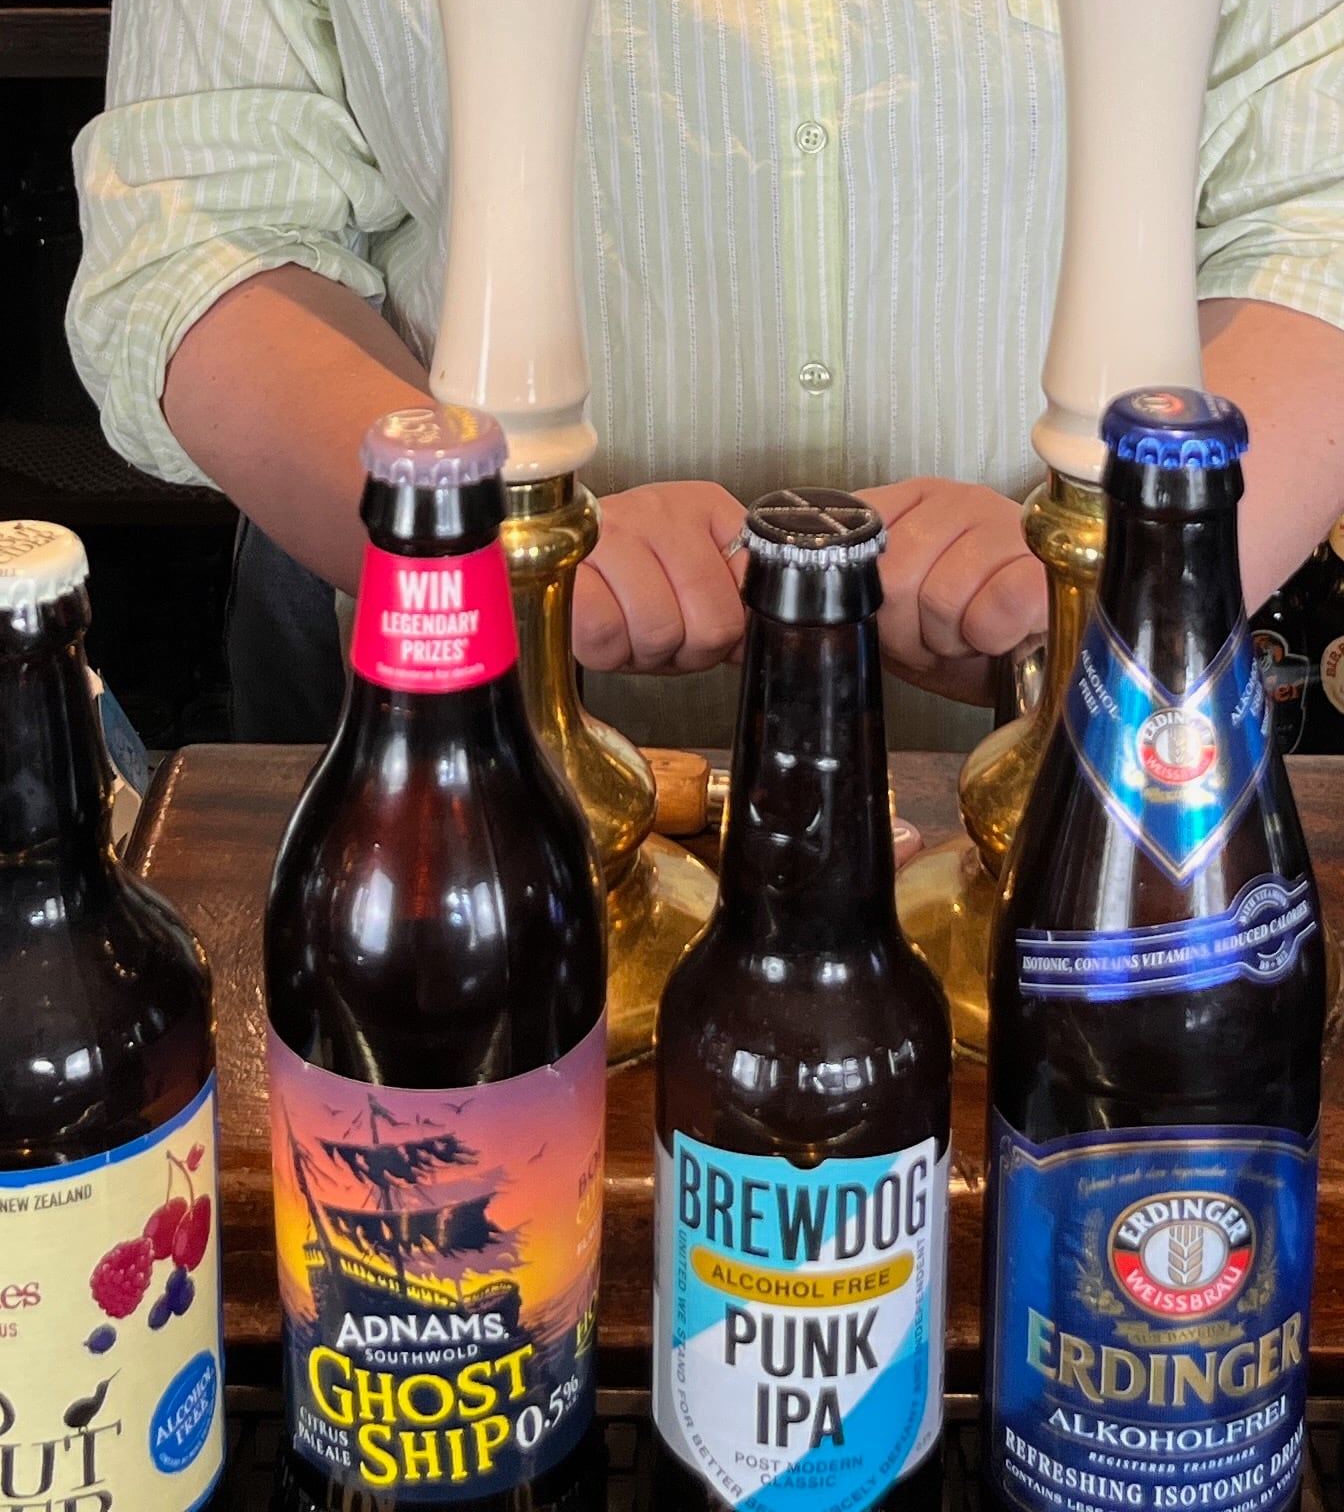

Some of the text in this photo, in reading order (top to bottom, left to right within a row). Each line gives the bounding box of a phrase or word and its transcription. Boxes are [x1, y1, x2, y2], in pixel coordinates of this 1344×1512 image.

[397, 569, 463, 610] WIN
[381, 609, 479, 638] LEGENDARY
[33, 1183, 93, 1210] ZEALAND
[679, 1144, 928, 1262] BREWDOG
[1117, 1198, 1250, 1246] ERDINGER
[711, 1263, 891, 1299] ALCOHOL FREE
[365, 1344, 479, 1365] SOUTHWOLD
[724, 1301, 879, 1379] PUNK
[1026, 1306, 1303, 1407] ERDINGER
[156, 1366, 216, 1446] ALCOHOL
[307, 1345, 536, 1426] GHOST
[175, 1394, 210, 1445] FREE
[298, 1405, 349, 1448] CITRUS
[674, 1327, 745, 1500] STAND FOR BETTER
[756, 1383, 845, 1449] IPA
[1047, 1393, 1288, 1452] ALKOHOLFREI
[296, 1425, 352, 1468] PALE ALE
[357, 1415, 511, 1485] SHIP
[734, 1450, 864, 1474] POST MODERN
[1005, 1425, 1143, 1505] REFRESHING
[1153, 1465, 1265, 1507] ISOTONIC
[1088, 1446, 1257, 1474] REGISTERED TRADEMARK
[760, 1473, 838, 1488] CLASSIC
[1005, 1457, 1062, 1505] CONTAINS
